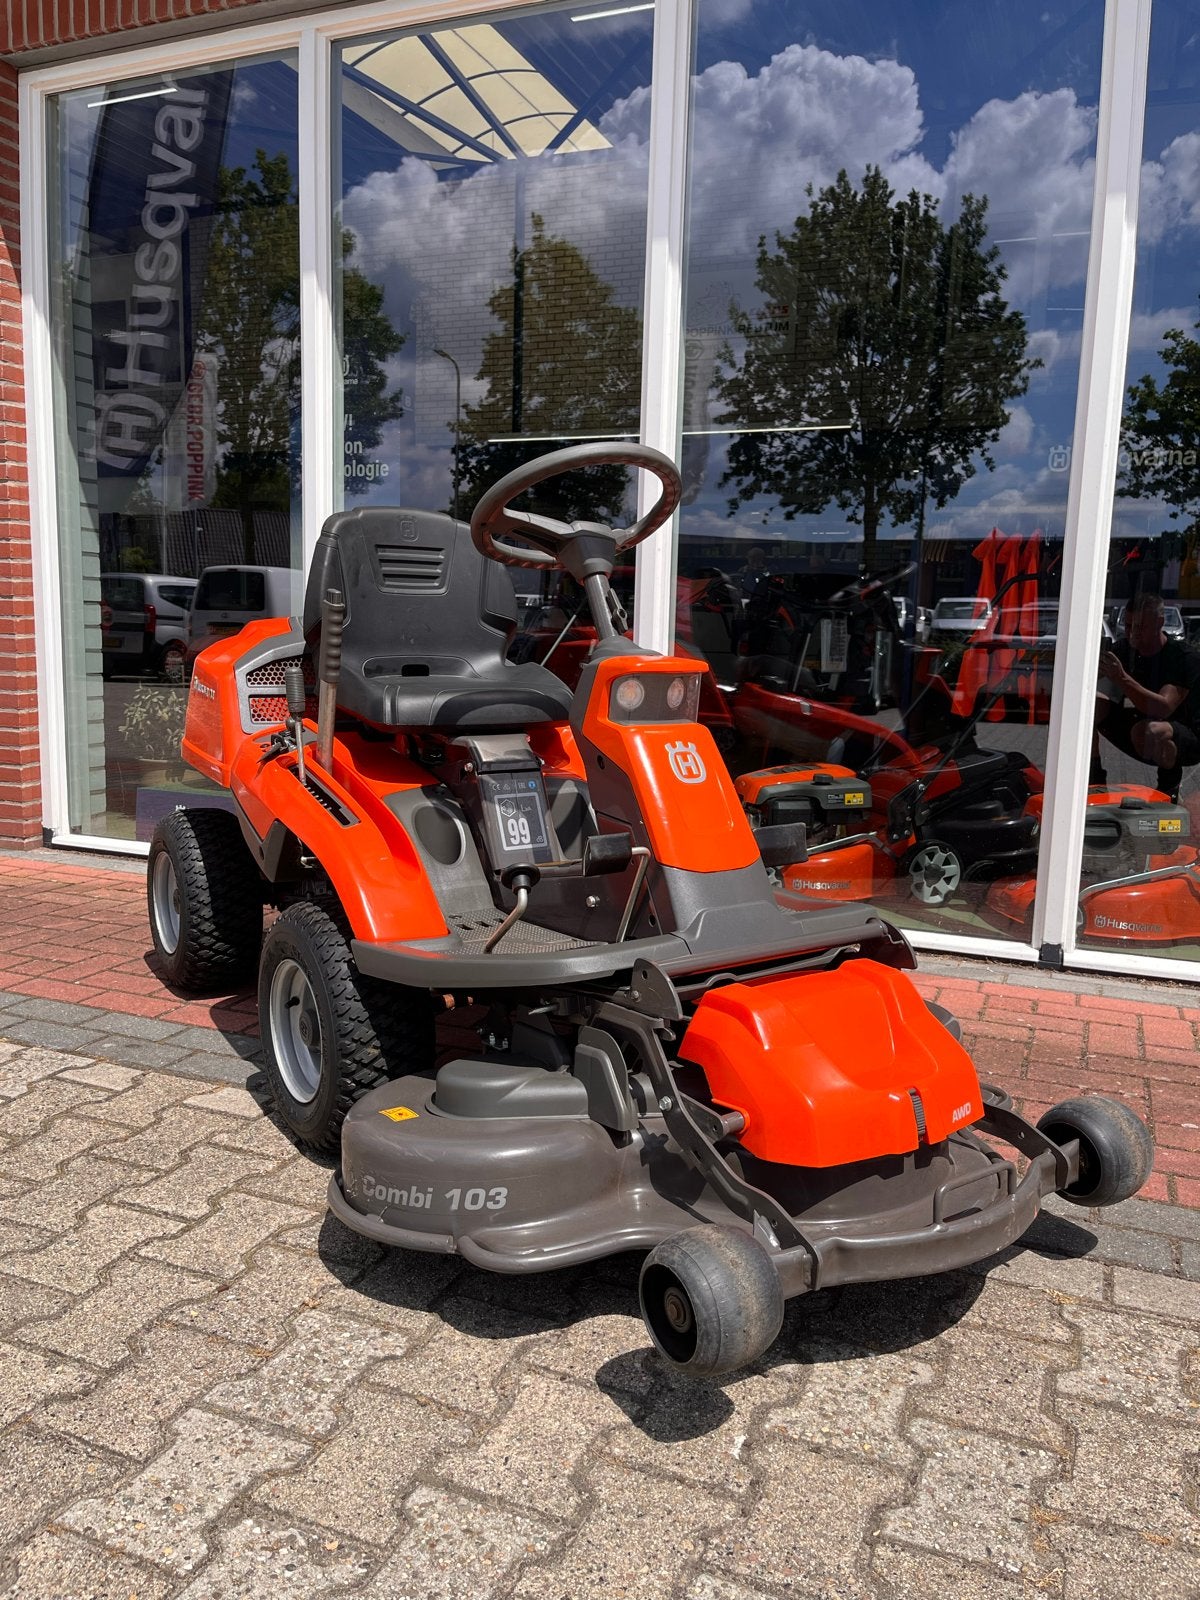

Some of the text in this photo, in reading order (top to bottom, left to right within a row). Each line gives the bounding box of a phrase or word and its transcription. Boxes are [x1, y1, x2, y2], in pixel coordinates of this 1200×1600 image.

[507, 817, 531, 846] 99
[1106, 918, 1162, 934] Husqvarna
[952, 1101, 972, 1124] AWD
[363, 1175, 508, 1211] Combi 103
